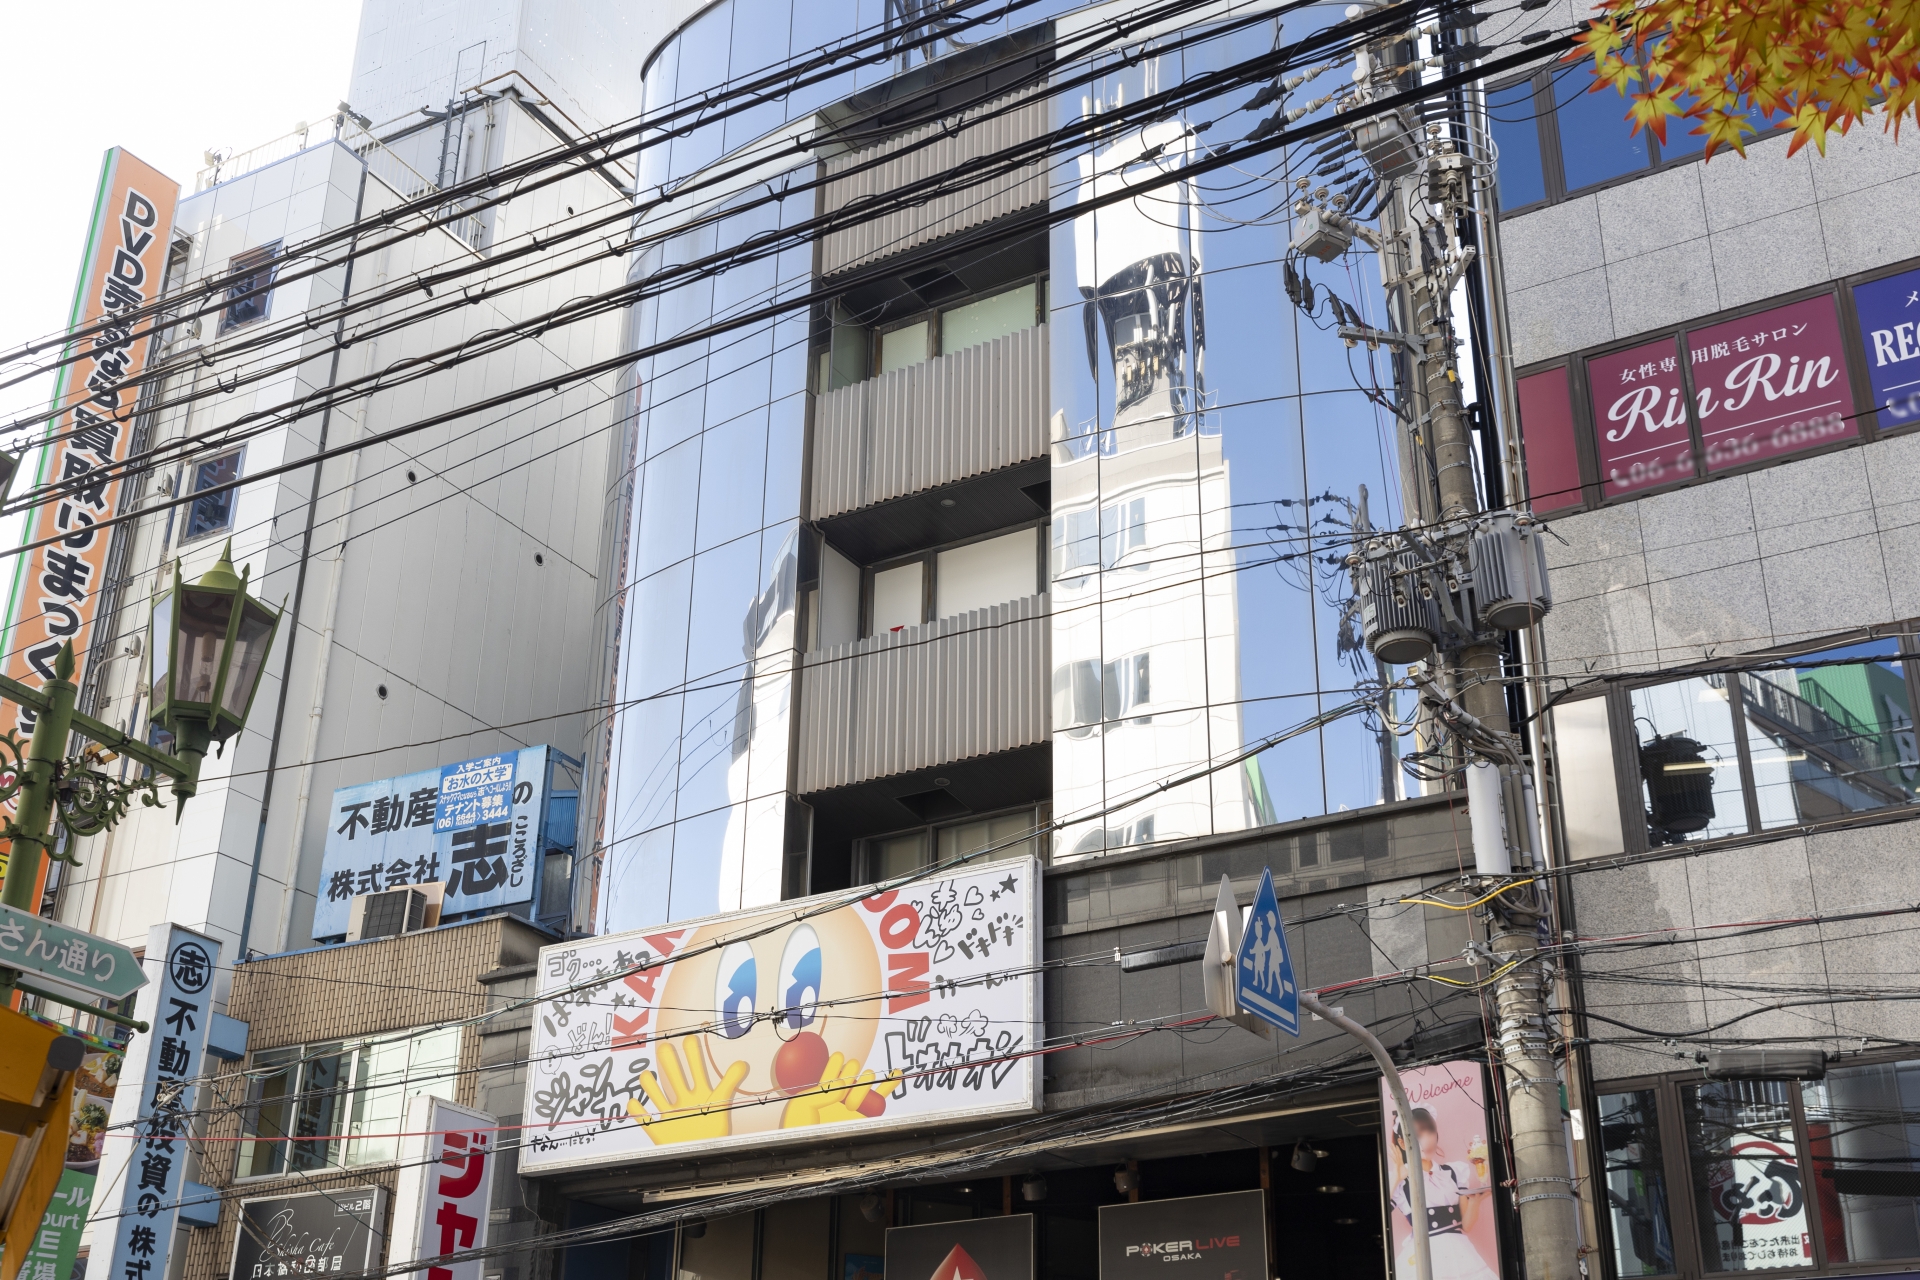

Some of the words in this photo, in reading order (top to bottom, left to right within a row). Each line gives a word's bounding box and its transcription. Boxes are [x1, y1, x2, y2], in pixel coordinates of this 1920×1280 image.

[1871, 321, 1920, 367] RE
[1606, 384, 1719, 443] Rin
[1724, 353, 1839, 411] Rin
[456, 756, 501, 774] 入学ご案内
[337, 786, 438, 841] 不動産
[512, 781, 533, 805] の
[436, 816, 454, 831] (06)
[482, 806, 508, 821] 3444
[444, 794, 504, 817] テナント募集
[445, 821, 512, 899] 志
[509, 815, 528, 888] こころざし
[327, 851, 441, 903] 株式会社
[175, 949, 209, 988] 志
[1389, 1074, 1474, 1106] Welcome
[309, 1227, 341, 1257] Cafe
[1162, 1253, 1202, 1262] OSAKA
[1195, 1235, 1240, 1251] LIVE
